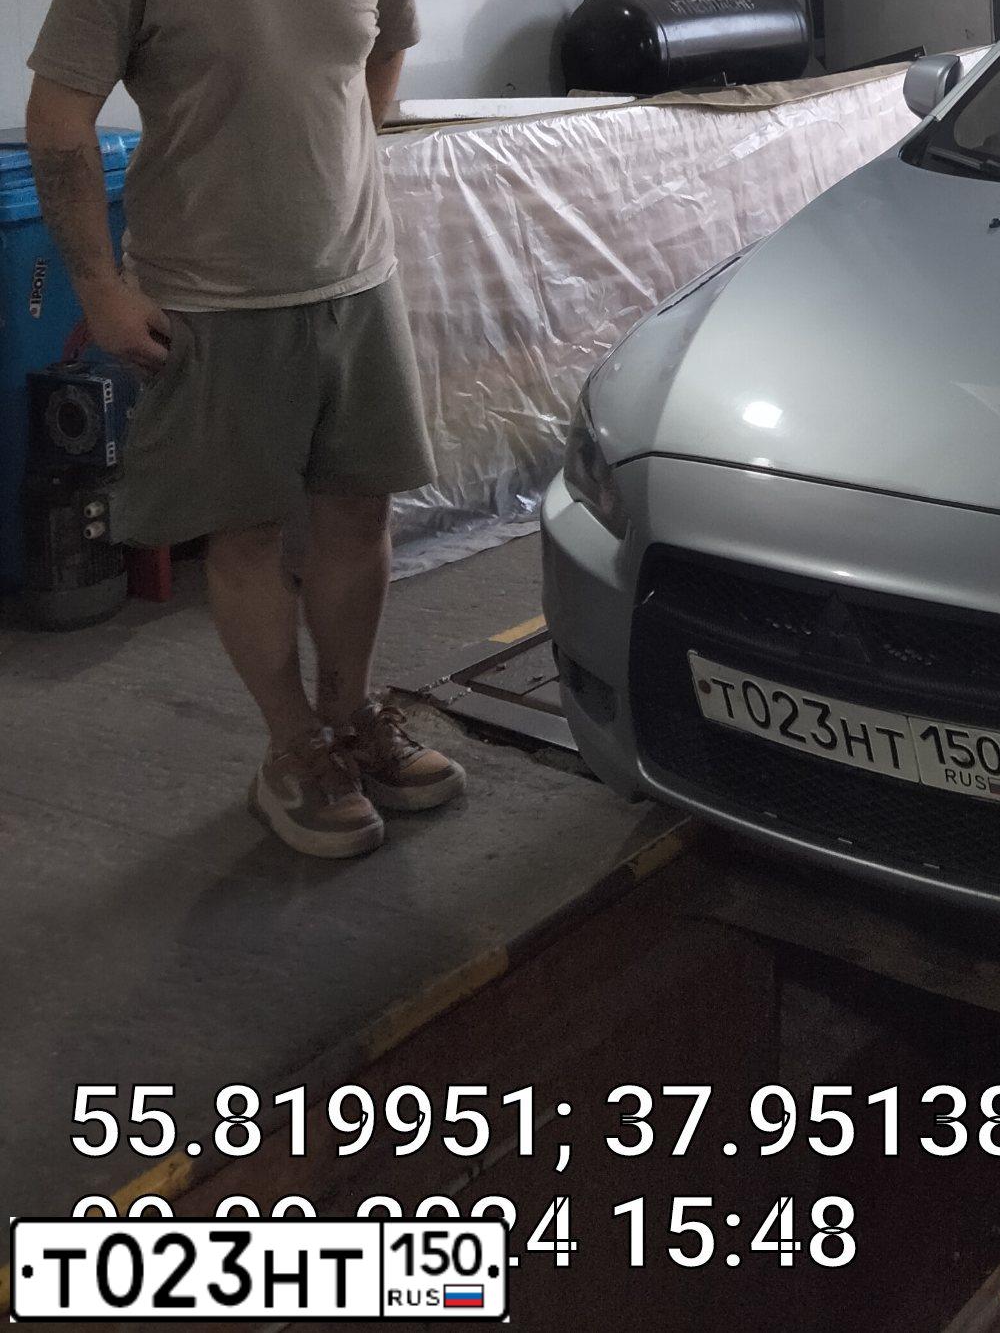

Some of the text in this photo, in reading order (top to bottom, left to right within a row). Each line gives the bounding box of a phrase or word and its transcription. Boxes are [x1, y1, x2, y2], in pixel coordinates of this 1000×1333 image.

[31, 257, 48, 305] IPONE
[710, 677, 905, 769] Т023НТ
[945, 768, 987, 791] RUS
